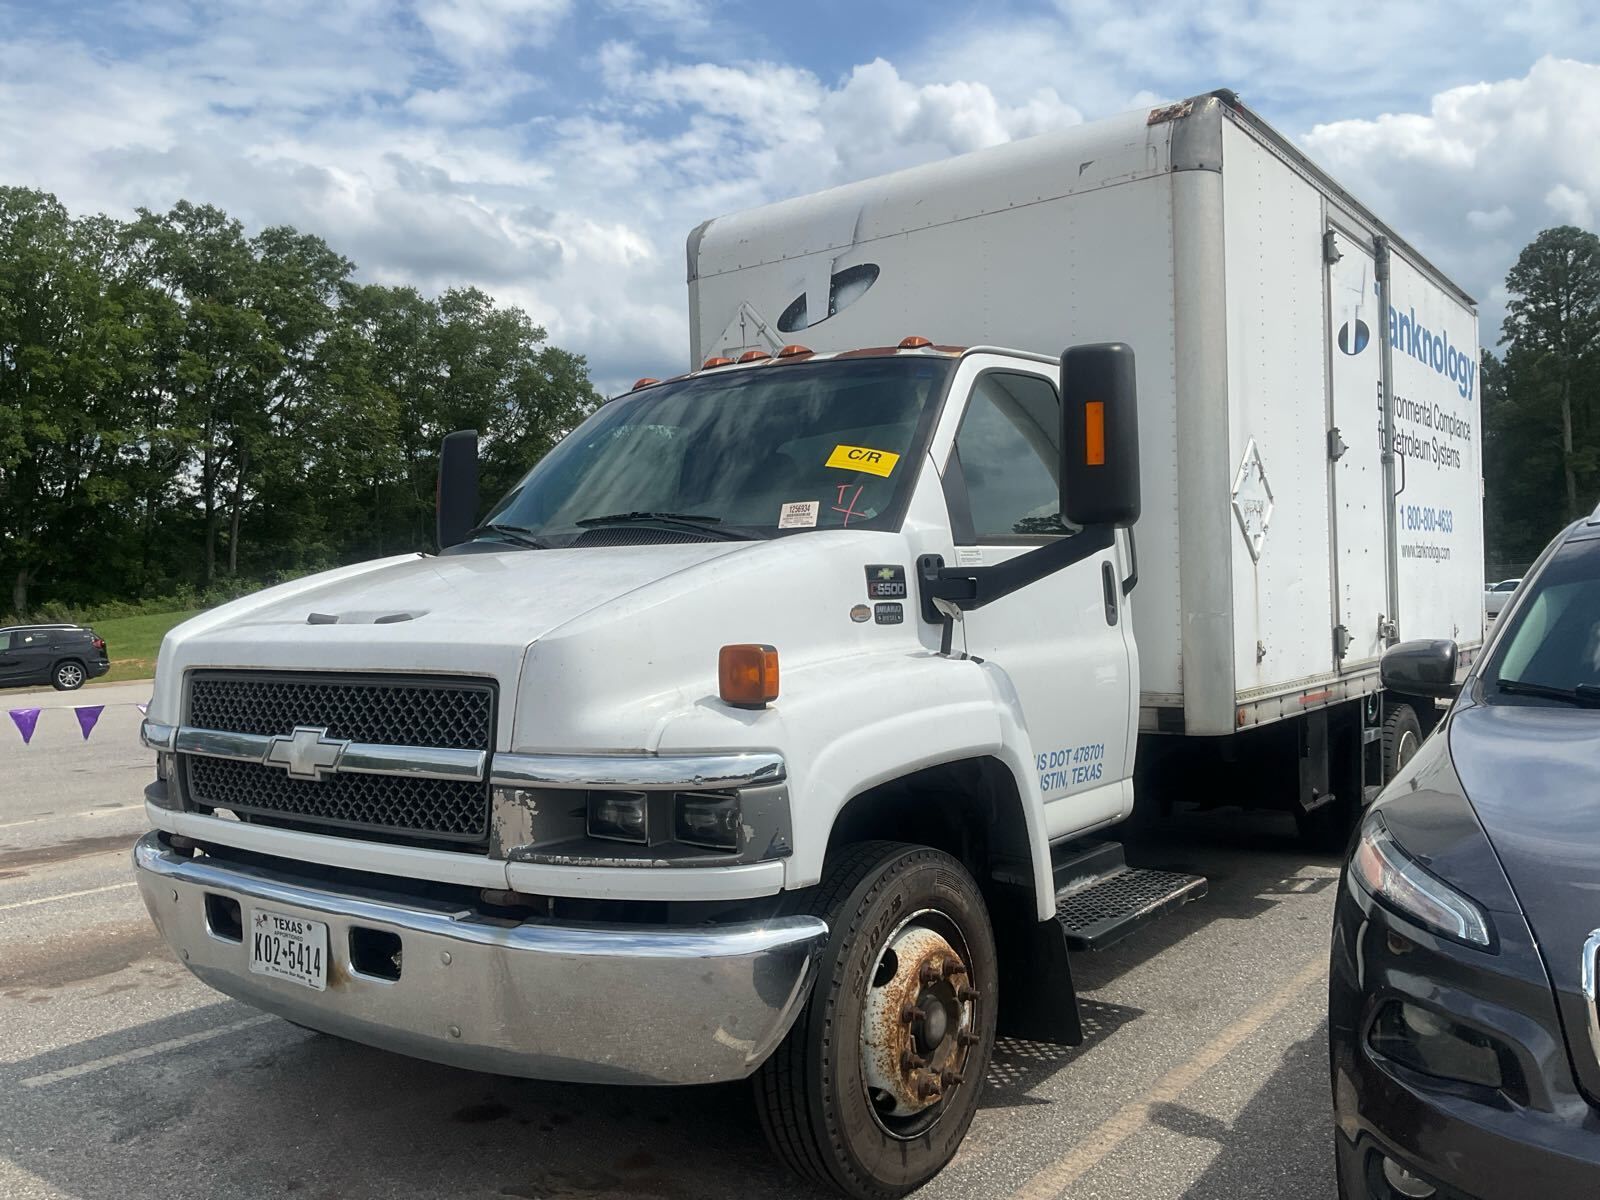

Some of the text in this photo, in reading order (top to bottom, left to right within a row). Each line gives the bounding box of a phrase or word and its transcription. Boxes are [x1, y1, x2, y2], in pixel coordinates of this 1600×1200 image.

[1374, 282, 1475, 400] anknology
[1377, 380, 1471, 441] Eronmental Compliance
[847, 449, 882, 464] C/R
[1432, 436, 1461, 471] Systems
[1400, 504, 1405, 530] 1
[1049, 749, 1072, 769] DOT
[1073, 743, 1105, 764] 478701
[1072, 763, 1103, 785] TEXAS
[273, 917, 303, 934] TEXAS
